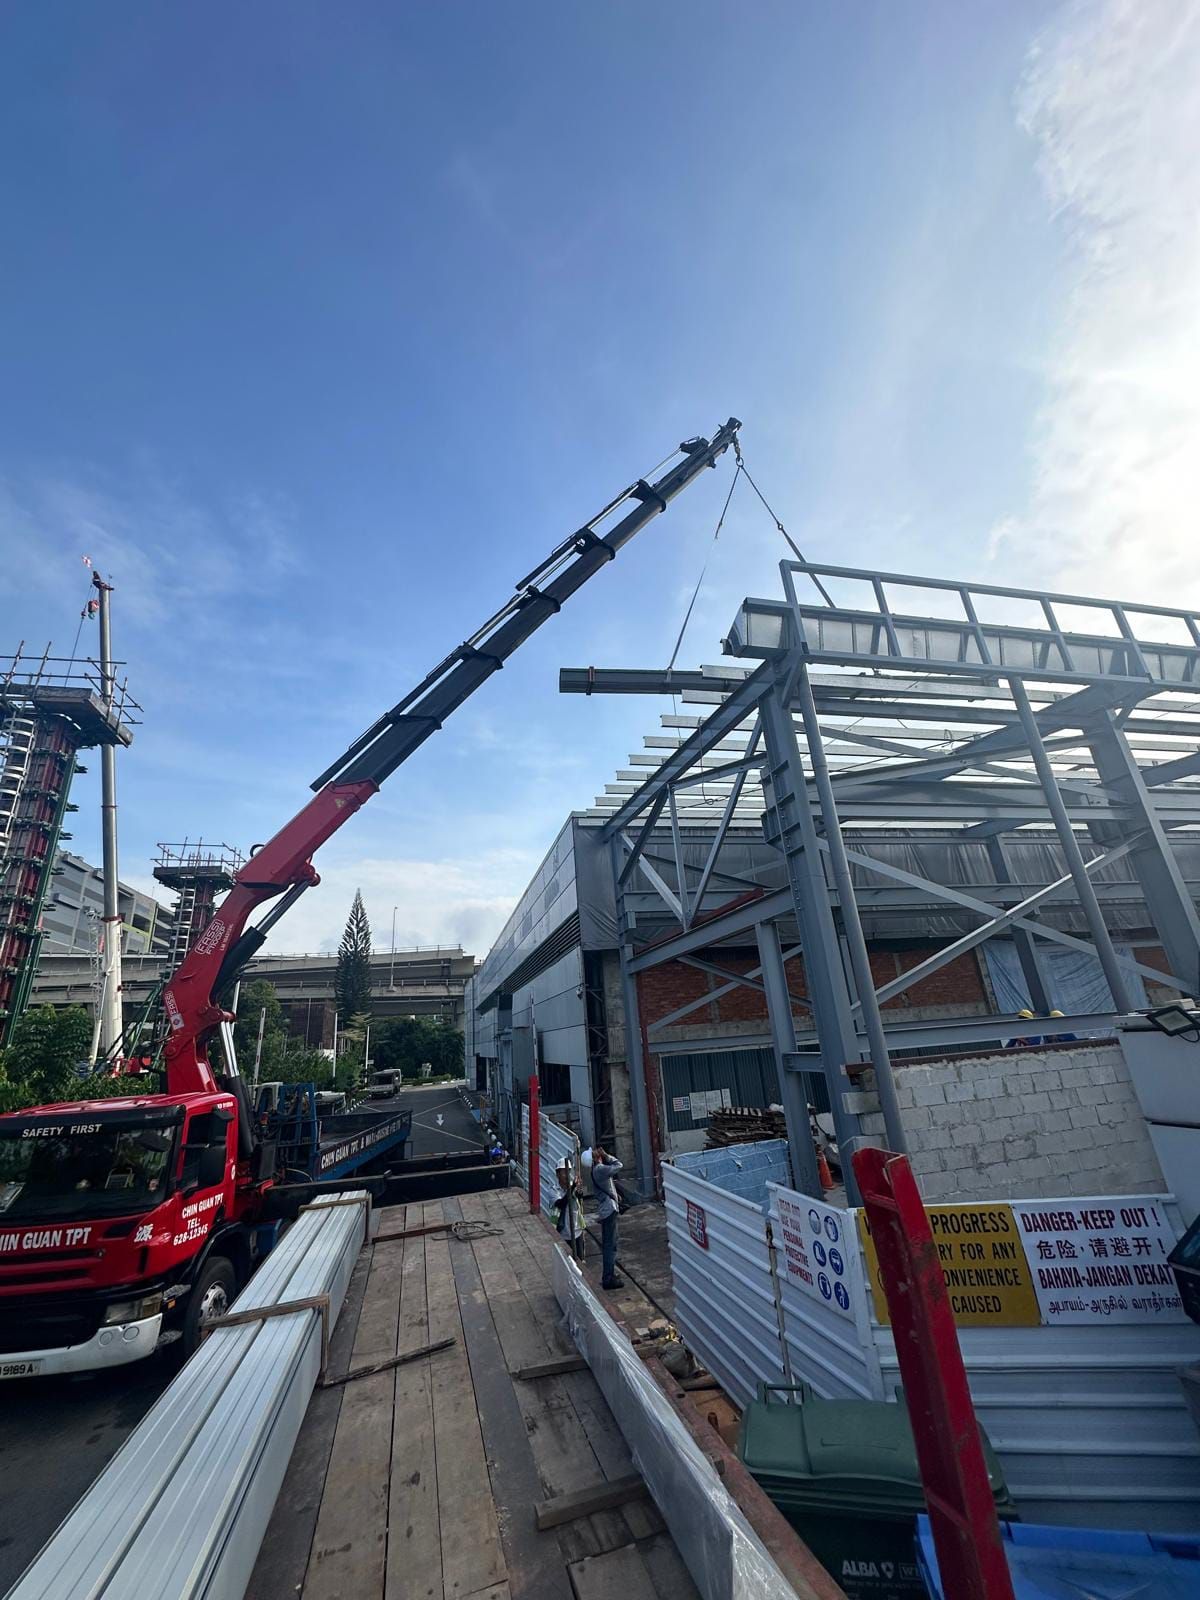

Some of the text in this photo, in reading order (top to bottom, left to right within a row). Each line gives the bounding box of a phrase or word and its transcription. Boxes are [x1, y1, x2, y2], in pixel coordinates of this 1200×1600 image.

[197, 921, 221, 952] FASSI
[22, 1123, 102, 1138] SAFETY FIRST
[182, 1193, 223, 1219] CHIN GUAN TPT
[187, 1217, 201, 1230] TEL:
[930, 1212, 1010, 1235] PROGRESS
[1020, 1209, 1116, 1233] DANGER-KEEP
[1120, 1208, 1149, 1228] OUT
[22, 1229, 63, 1249] GUAN
[65, 1227, 92, 1246] TPT
[174, 1224, 208, 1245] 628-12345
[959, 1243, 986, 1260] FOR
[991, 1242, 1017, 1260] ANY
[943, 1267, 1022, 1287] ONVENIENCE
[1037, 1263, 1175, 1290] BAHAYA-JANGAN DEKAT
[951, 1295, 1002, 1314] CAUSED
[842, 1560, 880, 1578] ALBA
